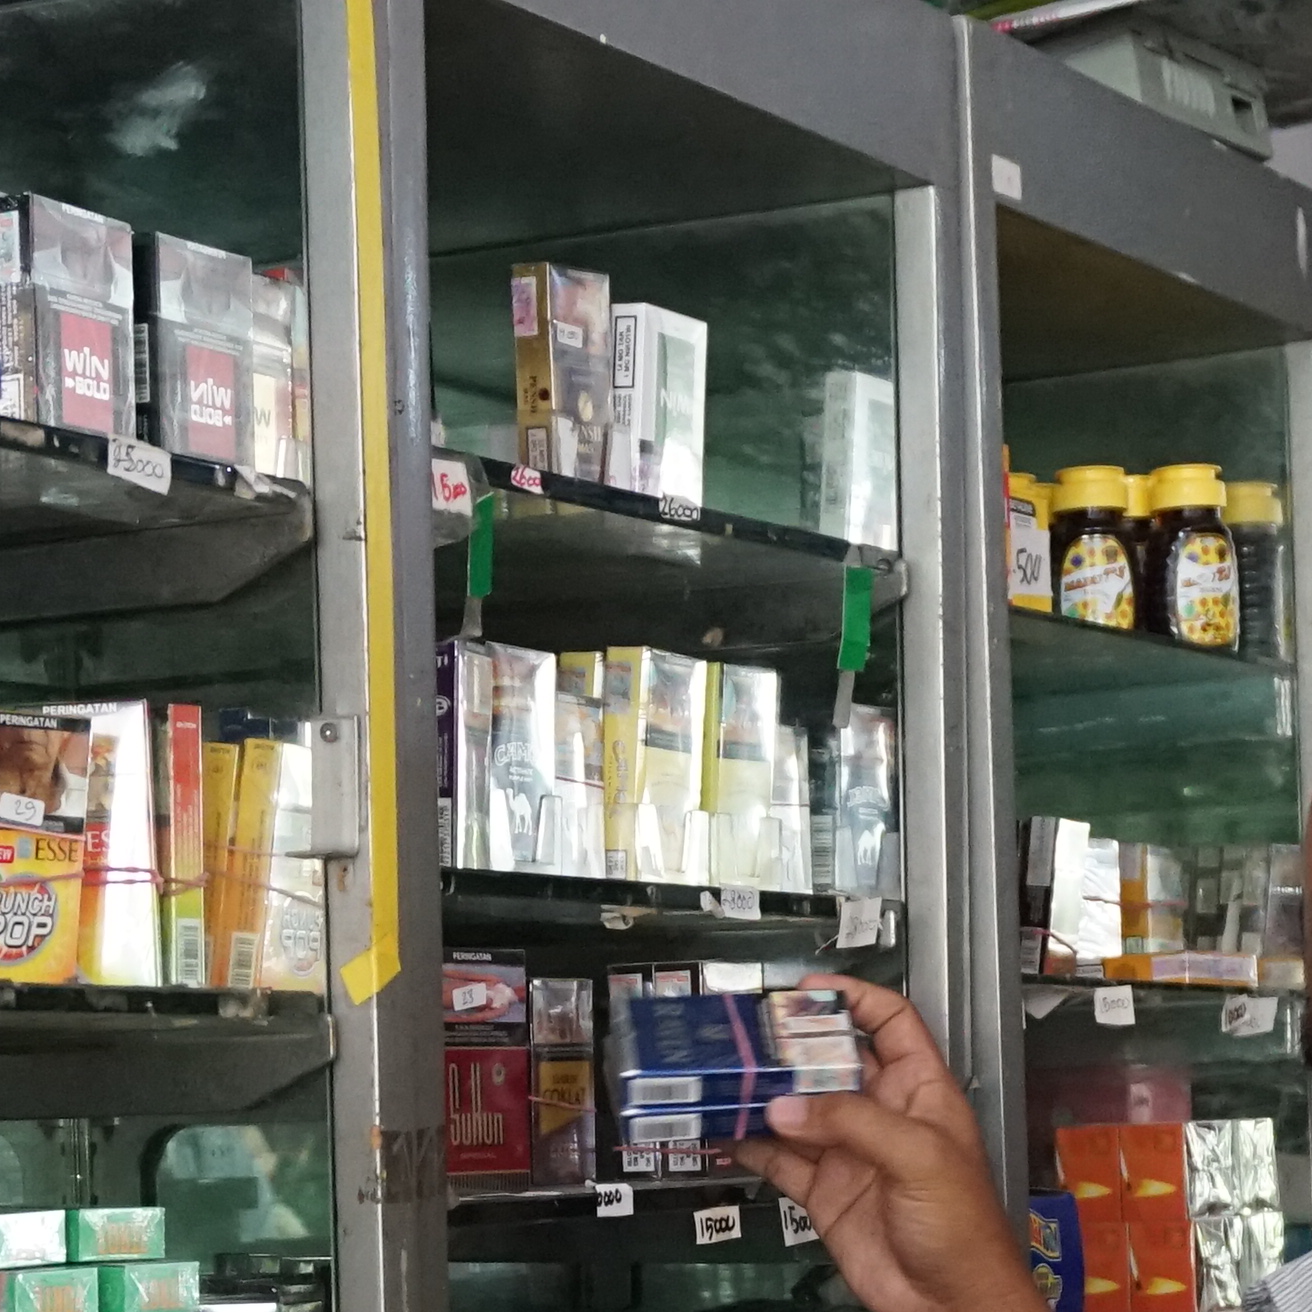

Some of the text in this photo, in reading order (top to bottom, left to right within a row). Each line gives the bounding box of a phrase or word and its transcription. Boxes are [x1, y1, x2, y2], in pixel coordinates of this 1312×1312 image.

[64, 346, 110, 381] WIN
[75, 376, 110, 401] BOLD
[42, 702, 119, 716] PERINGATAN
[0, 713, 58, 730] PERINGATAN
[13, 801, 37, 821] 29
[35, 837, 79, 863] ESSE
[453, 951, 492, 962] PERINGATAN
